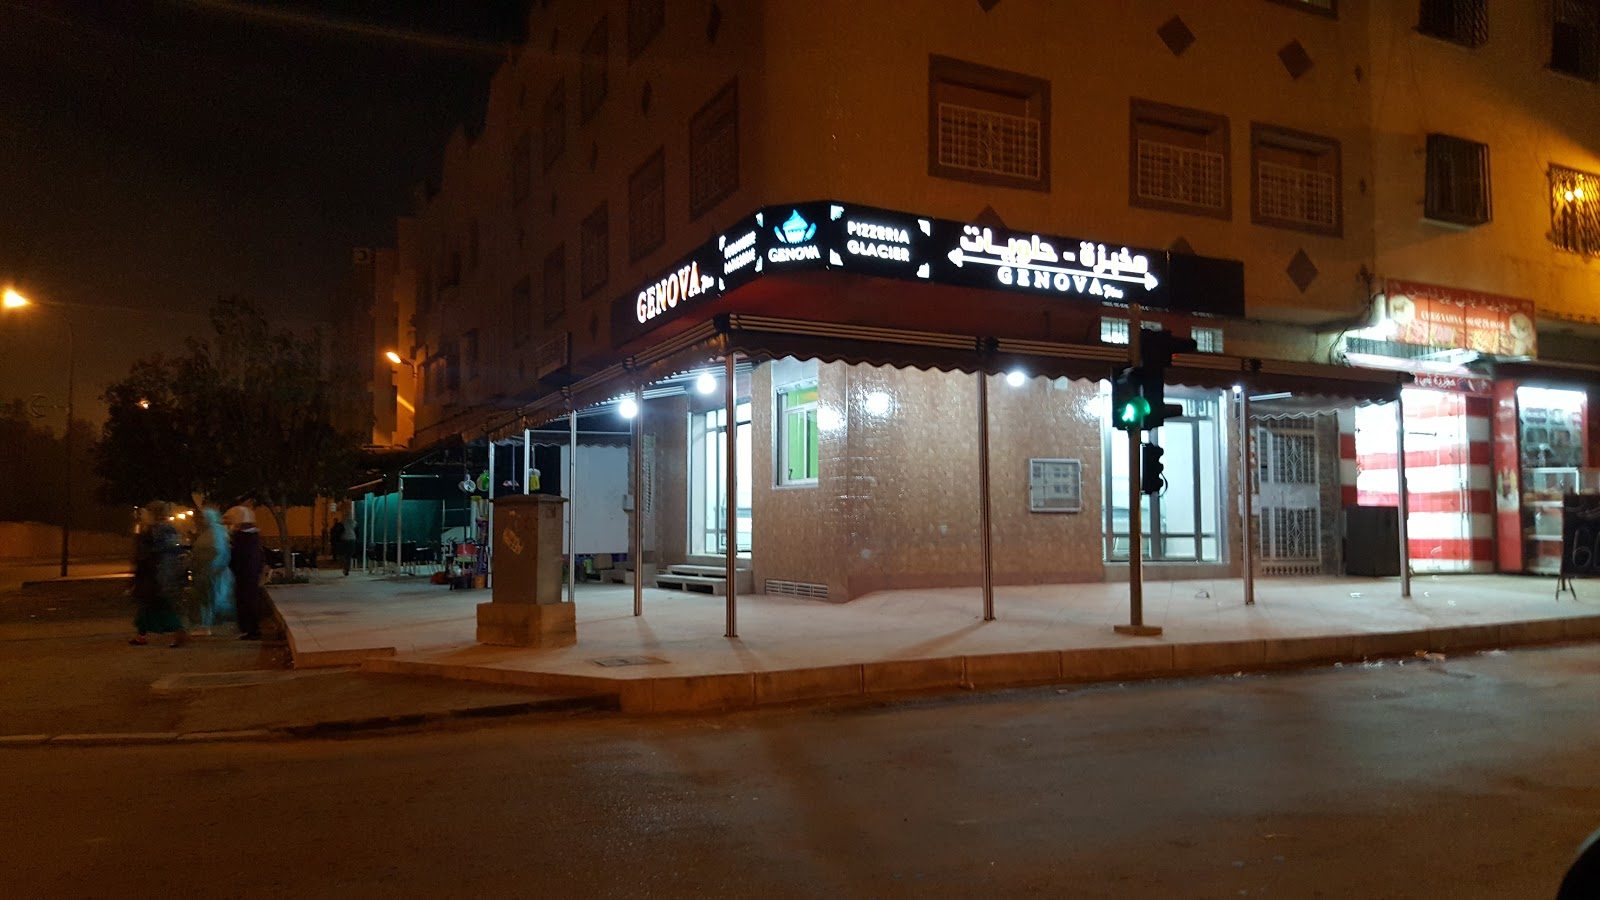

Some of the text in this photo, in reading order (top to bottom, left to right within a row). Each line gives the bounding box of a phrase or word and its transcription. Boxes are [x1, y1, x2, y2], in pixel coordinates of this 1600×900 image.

[847, 221, 910, 244] PIZZERIA
[959, 224, 1059, 264] حلويات
[768, 245, 821, 263] GENOVA
[846, 239, 910, 262] GLACIER
[1079, 240, 1149, 276] مخبزة
[636, 260, 700, 324] GENOVA
[997, 267, 1103, 295] GENOVA
